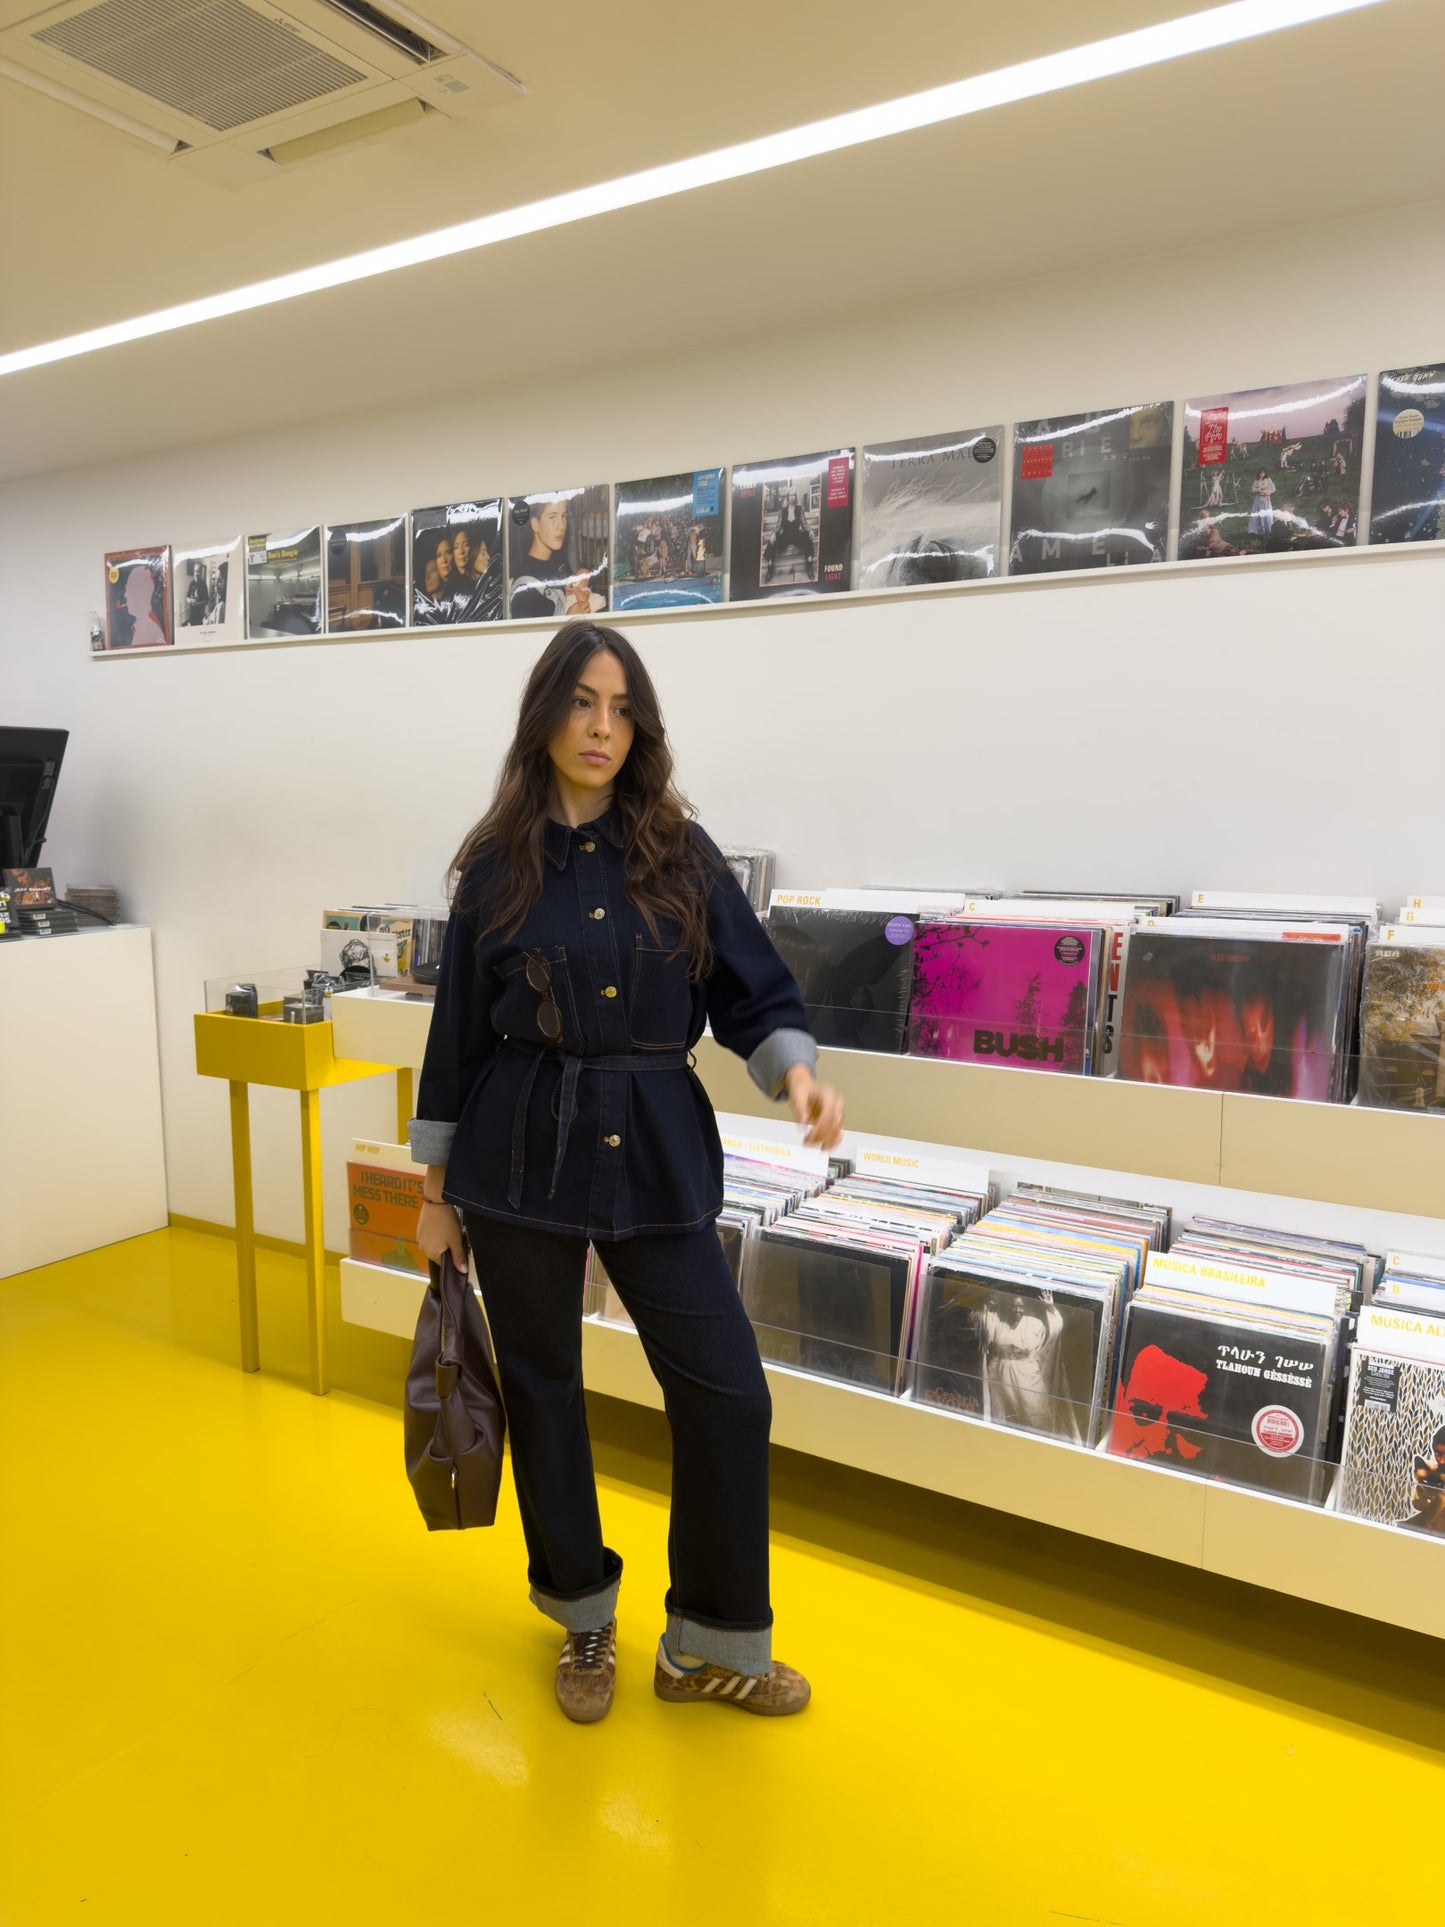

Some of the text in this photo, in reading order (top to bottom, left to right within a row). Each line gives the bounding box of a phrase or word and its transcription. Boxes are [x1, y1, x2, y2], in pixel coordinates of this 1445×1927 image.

[824, 563, 843, 573] FOUND
[776, 894, 821, 905] POP ROCK
[1198, 894, 1204, 903] E
[1413, 899, 1421, 909] H
[969, 902, 976, 912] C
[1406, 911, 1414, 922] G
[1387, 929, 1395, 941] F
[1375, 949, 1400, 958] RCA
[973, 1029, 1065, 1063] BUSH
[355, 1143, 380, 1154] HIP HOP
[863, 1151, 919, 1168] WORLD MUSIC
[365, 1171, 402, 1190] HEARD
[352, 1184, 418, 1209] MESS THERE
[1392, 1255, 1400, 1266] C
[1153, 1257, 1267, 1288] MUSICA BRASILEIRA
[1370, 1313, 1423, 1334] MUSICA
[1216, 1359, 1262, 1378] TLAHOUN
